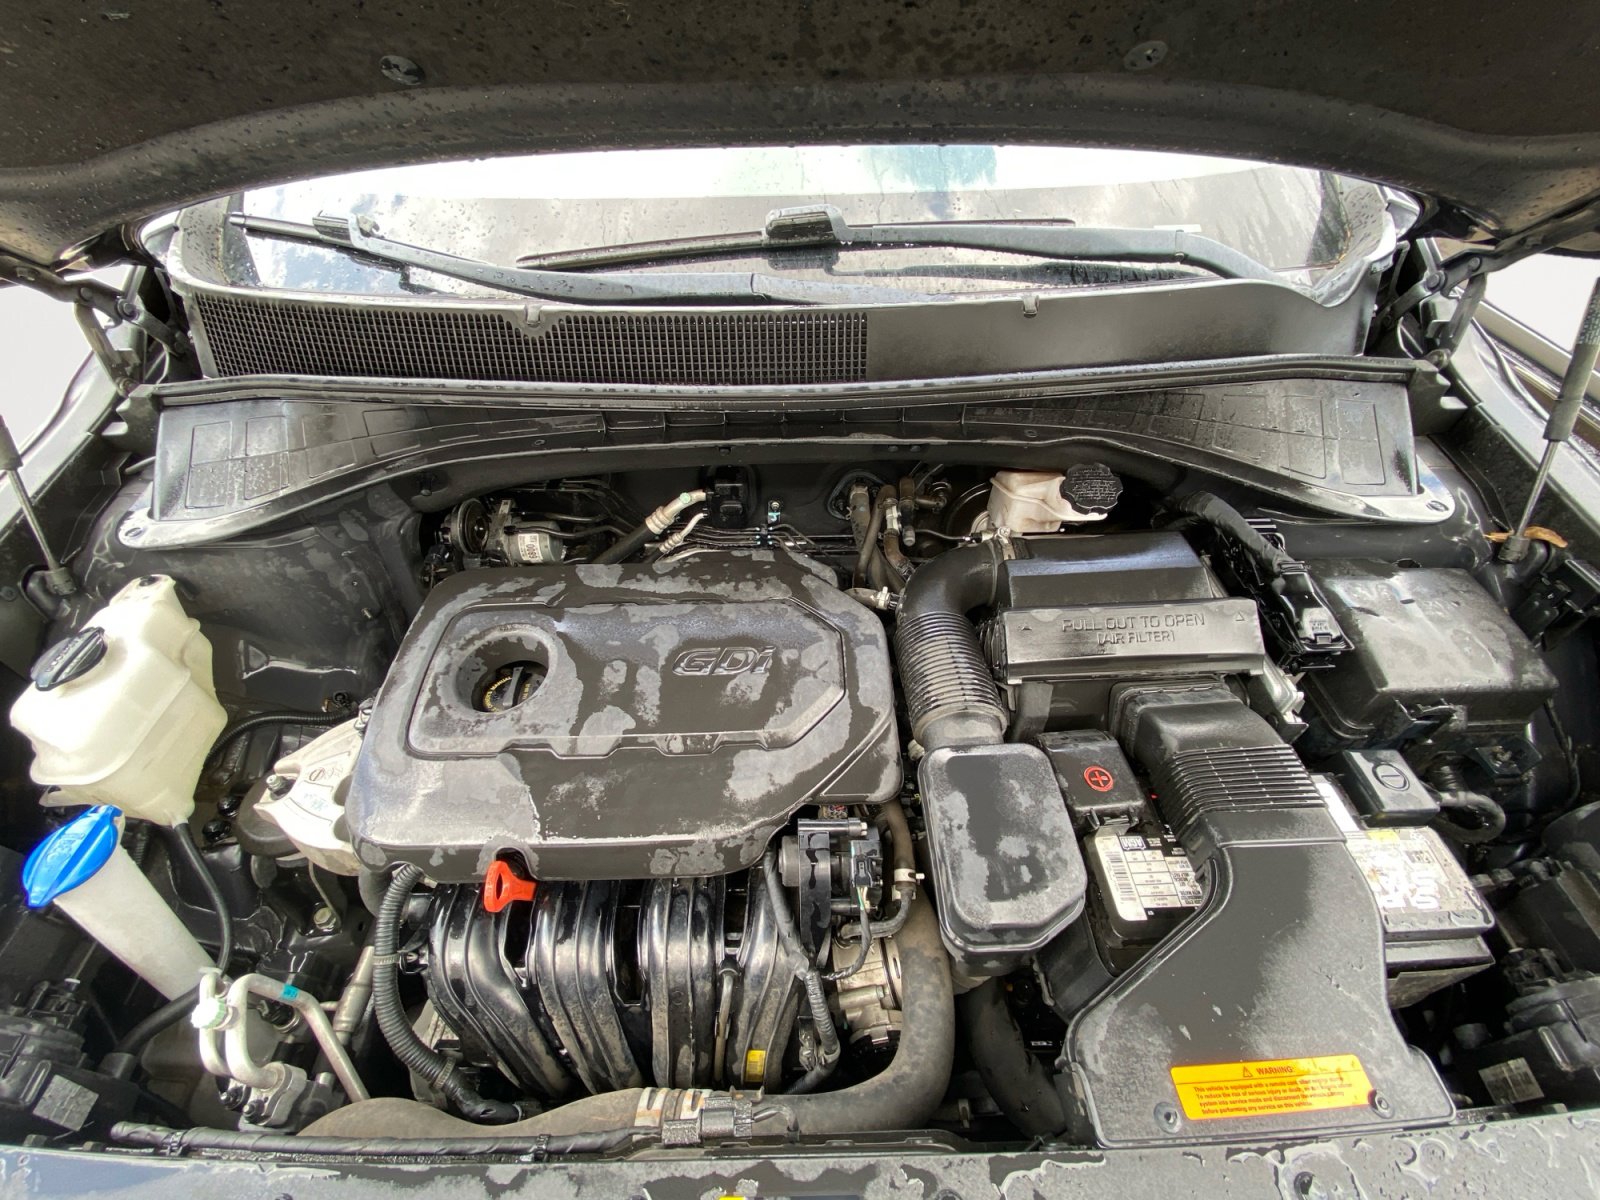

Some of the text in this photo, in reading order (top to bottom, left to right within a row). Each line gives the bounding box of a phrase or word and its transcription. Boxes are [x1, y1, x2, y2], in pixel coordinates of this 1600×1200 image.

[1062, 613, 1205, 632] PULL OUT TO OPEN
[672, 646, 777, 676] GDi
